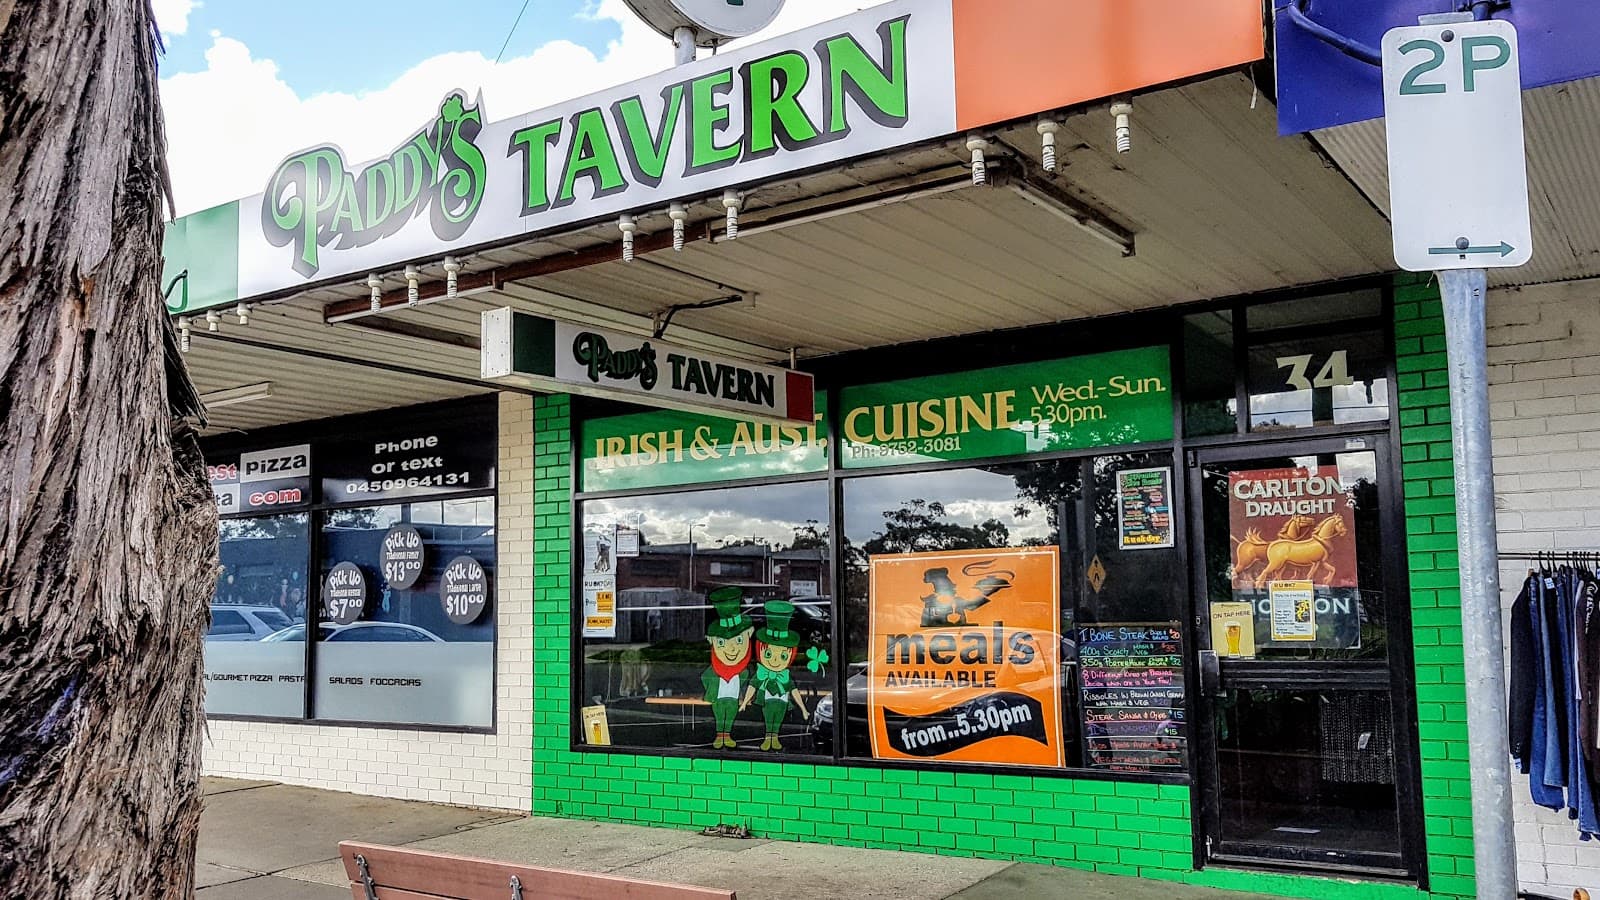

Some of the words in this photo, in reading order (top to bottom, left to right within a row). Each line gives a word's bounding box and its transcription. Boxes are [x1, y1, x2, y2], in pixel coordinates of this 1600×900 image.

[1398, 36, 1511, 95] 2P
[262, 94, 487, 279] PADDY'S
[507, 14, 911, 217] TAVERN
[573, 331, 658, 391] PADDY'S
[667, 353, 775, 409] TAVERN
[1276, 350, 1354, 391] 34
[595, 430, 685, 470] IRISH
[690, 426, 723, 460] &
[844, 390, 1017, 443] CUISINE
[375, 436, 438, 454] Phone
[852, 449, 876, 465] Ph:
[880, 436, 961, 462] 9752-3081
[207, 463, 237, 481] est
[372, 461, 396, 474] or
[346, 472, 469, 493] 0450964131
[1234, 476, 1346, 500] CARLTON
[249, 488, 301, 505] com
[1245, 498, 1336, 517] DRAUGHT
[886, 621, 1036, 665] meals
[1090, 628, 1116, 642] BONE
[1119, 627, 1150, 642] STEAK
[1081, 658, 1102, 668] 350g
[250, 674, 273, 683] PIZZA
[329, 676, 363, 686] SALADS
[370, 676, 422, 688] FOCCACIAS
[886, 670, 997, 688] AVAILABLE
[1087, 709, 1115, 722] STEAK
